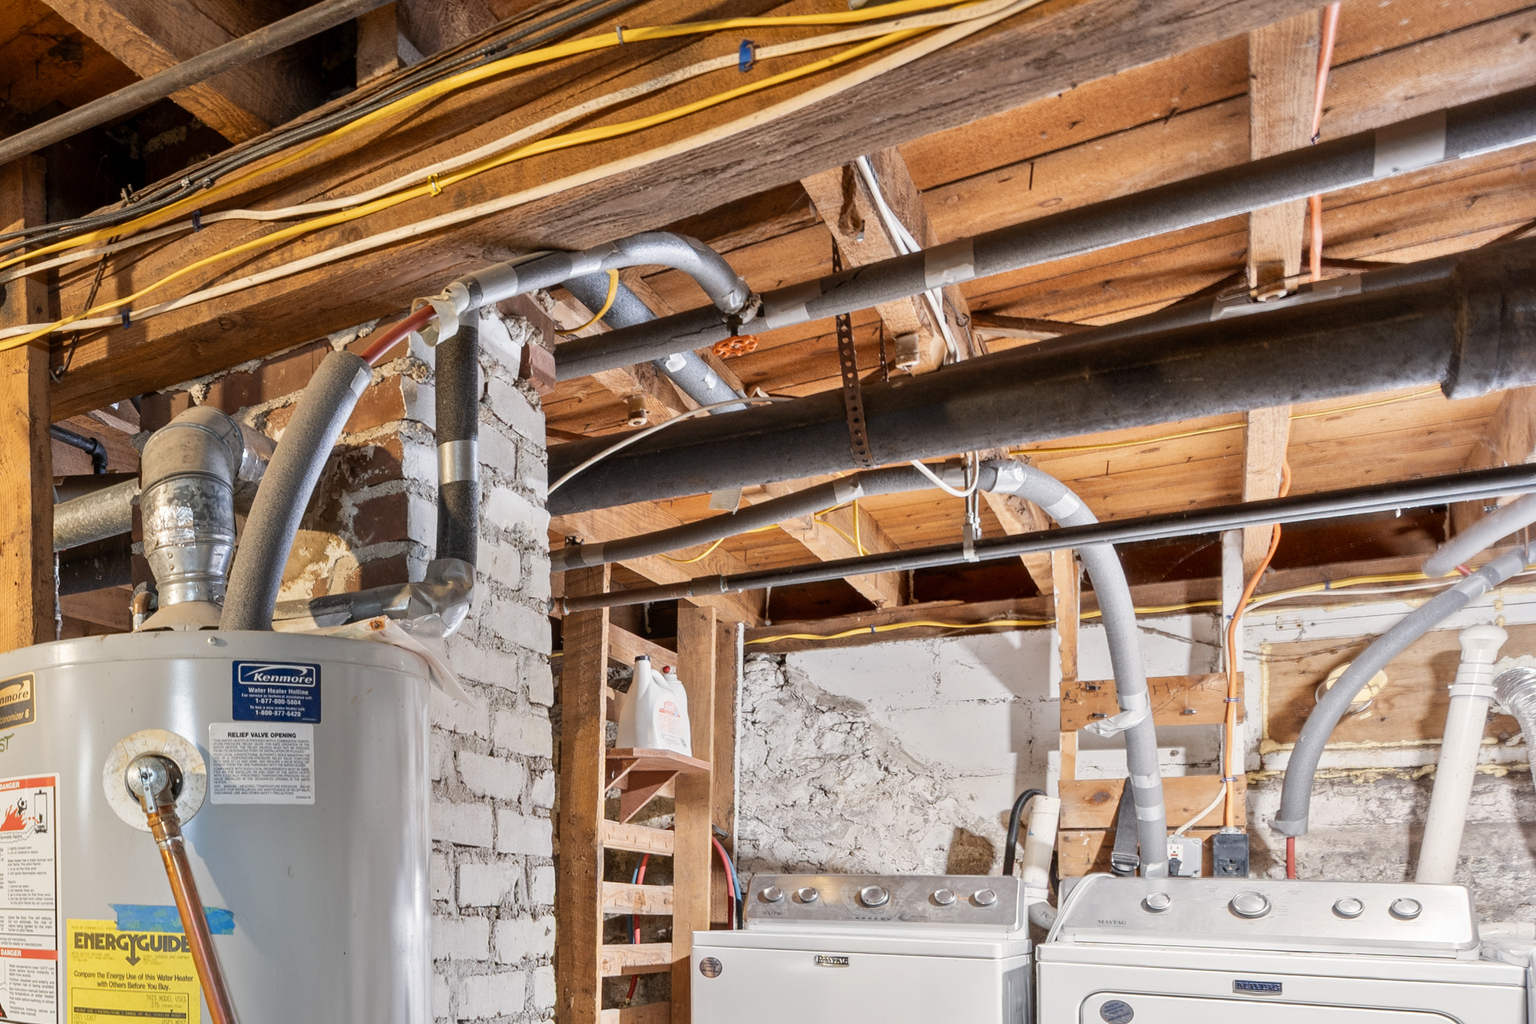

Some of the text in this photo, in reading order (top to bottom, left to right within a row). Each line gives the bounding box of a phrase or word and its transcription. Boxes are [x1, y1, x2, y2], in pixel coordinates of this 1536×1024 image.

[253, 673, 313, 684] Kenmore
[24, 708, 30, 719] 6
[0, 781, 20, 791] DANGER
[74, 932, 191, 953] ENERGYGUIDE
[0, 949, 22, 957] DANGER
[74, 970, 96, 979] Compare
[106, 972, 125, 981] Energy
[109, 981, 126, 989] Others
[128, 982, 146, 990] Before
[147, 982, 157, 990] You
[158, 983, 170, 992] Buy.
[1235, 981, 1281, 991] MAYTAG
